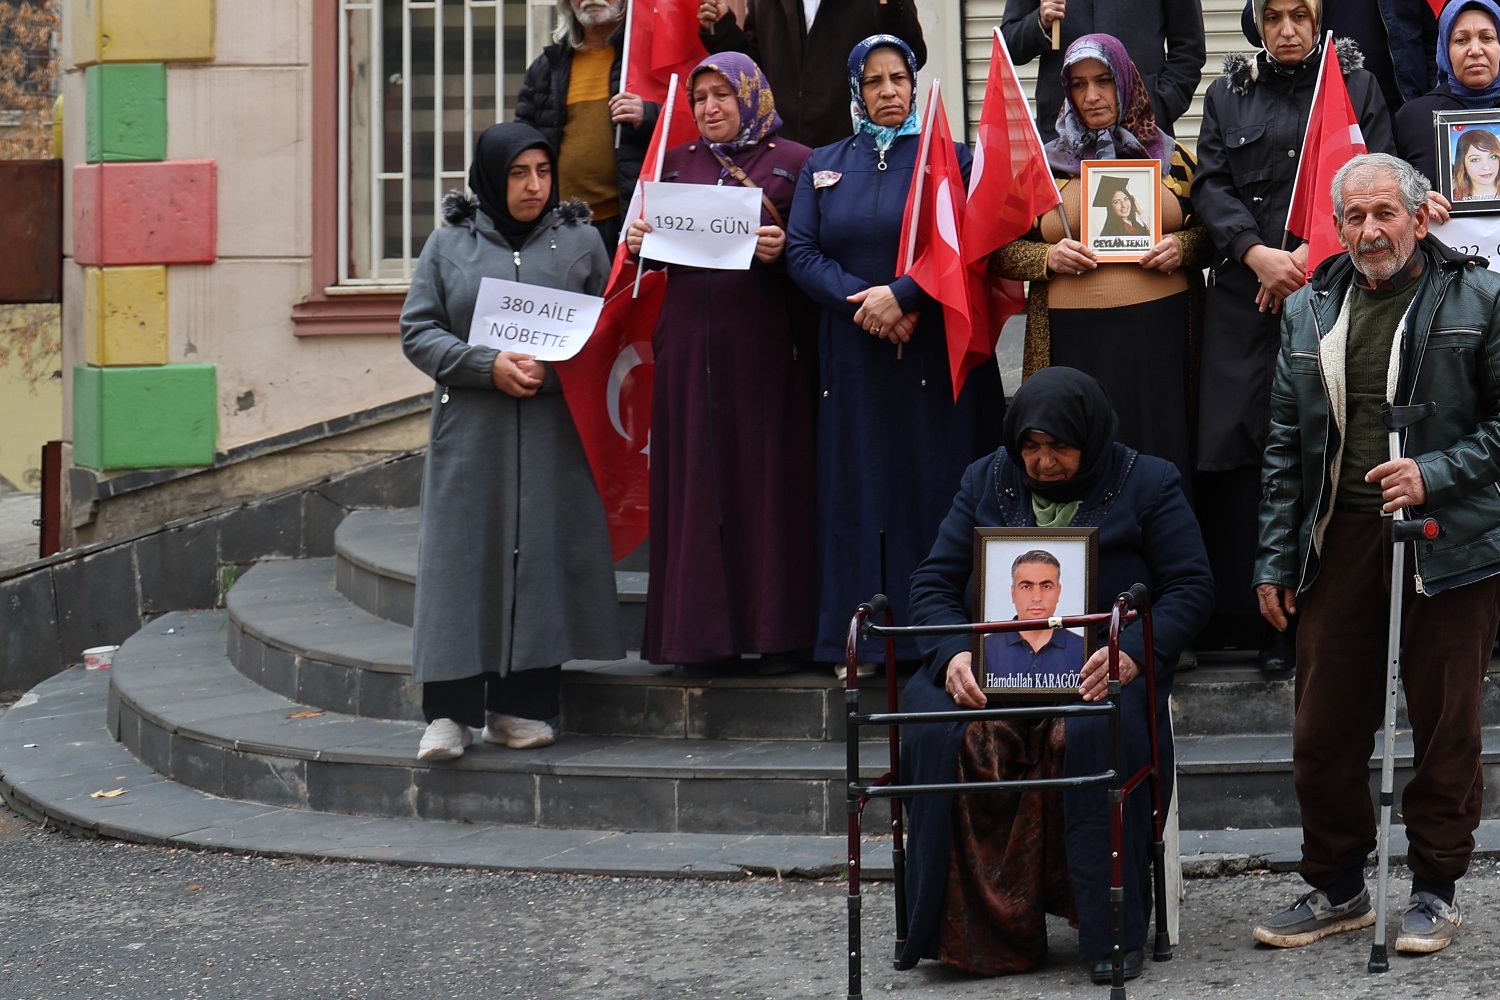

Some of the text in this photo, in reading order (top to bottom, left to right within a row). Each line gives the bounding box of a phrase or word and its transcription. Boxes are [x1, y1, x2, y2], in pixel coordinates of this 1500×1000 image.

[710, 217, 750, 235] GÜN
[500, 295, 578, 323] 380 AİLE
[489, 321, 570, 348] NÖBETTE
[986, 669, 1080, 688] Hamdullah KARAGÖZ
